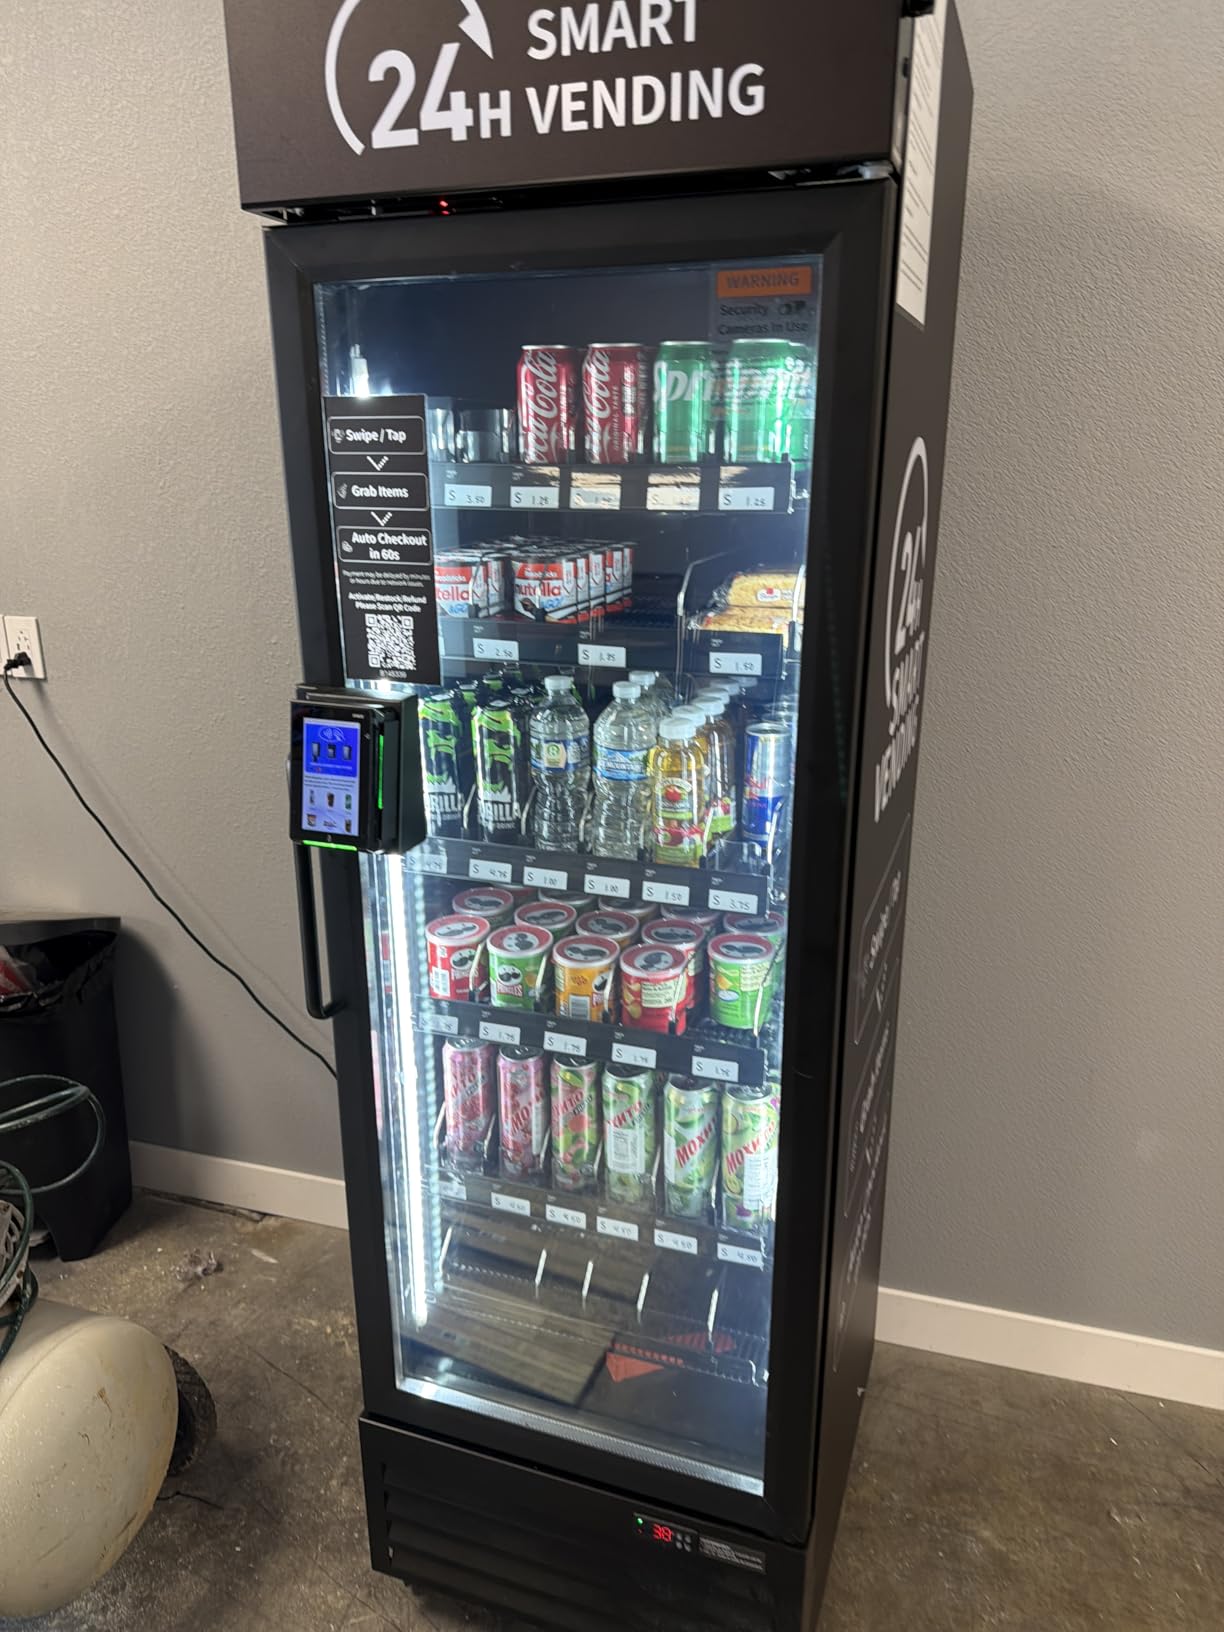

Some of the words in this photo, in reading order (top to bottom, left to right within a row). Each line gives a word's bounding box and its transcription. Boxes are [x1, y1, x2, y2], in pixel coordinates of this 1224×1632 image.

[526, 0, 698, 60] SMART
[525, 62, 766, 134] VENDING
[727, 271, 800, 289] WARNING
[719, 303, 768, 317] Security
[785, 319, 809, 332] Use
[345, 428, 379, 444] Swipe
[385, 428, 407, 444] Tap
[351, 484, 378, 498] Grab
[378, 485, 409, 498] Items
[351, 532, 377, 545] Auto
[377, 532, 428, 546] Checkout
[369, 548, 380, 560] in
[381, 549, 400, 562] 60s
[436, 586, 470, 601] tella
[496, 983, 523, 998] PRINGLES
